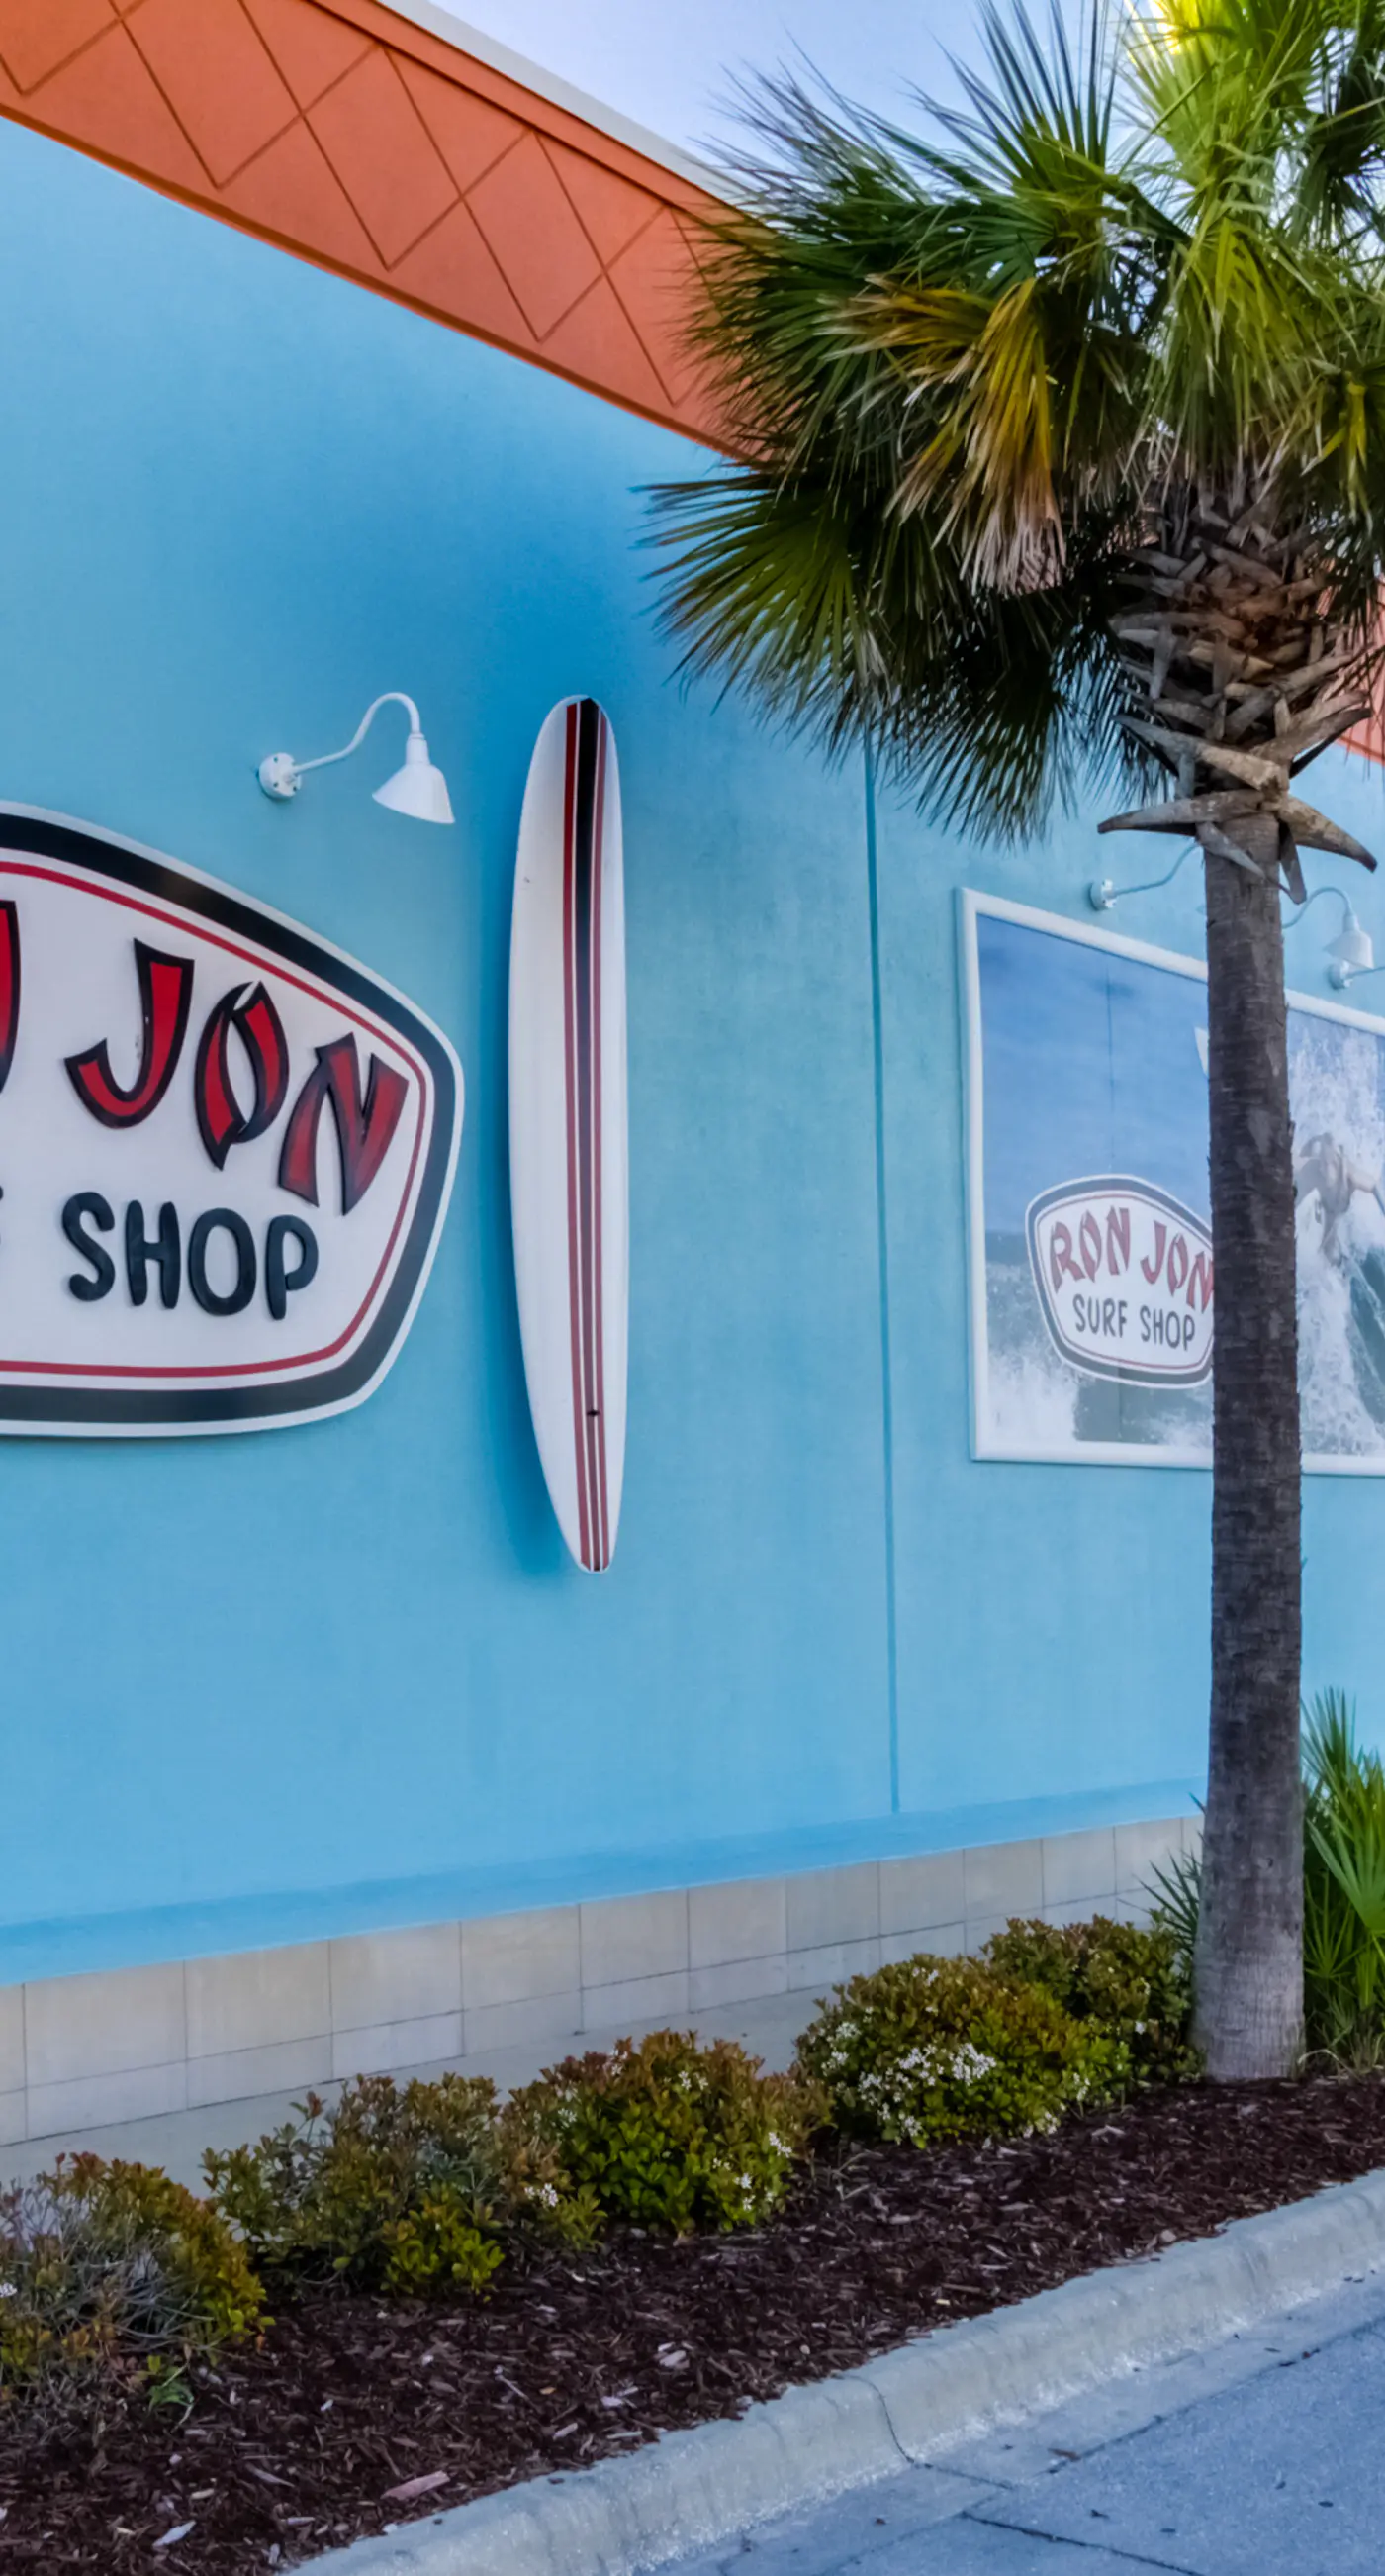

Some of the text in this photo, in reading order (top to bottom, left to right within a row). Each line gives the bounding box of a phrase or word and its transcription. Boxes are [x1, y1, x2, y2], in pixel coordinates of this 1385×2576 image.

[64, 938, 410, 1215] JON
[62, 1191, 319, 1320] SHOP
[1049, 1205, 1214, 1313] RON JON
[1072, 1293, 1195, 1351] SURF SHOP
